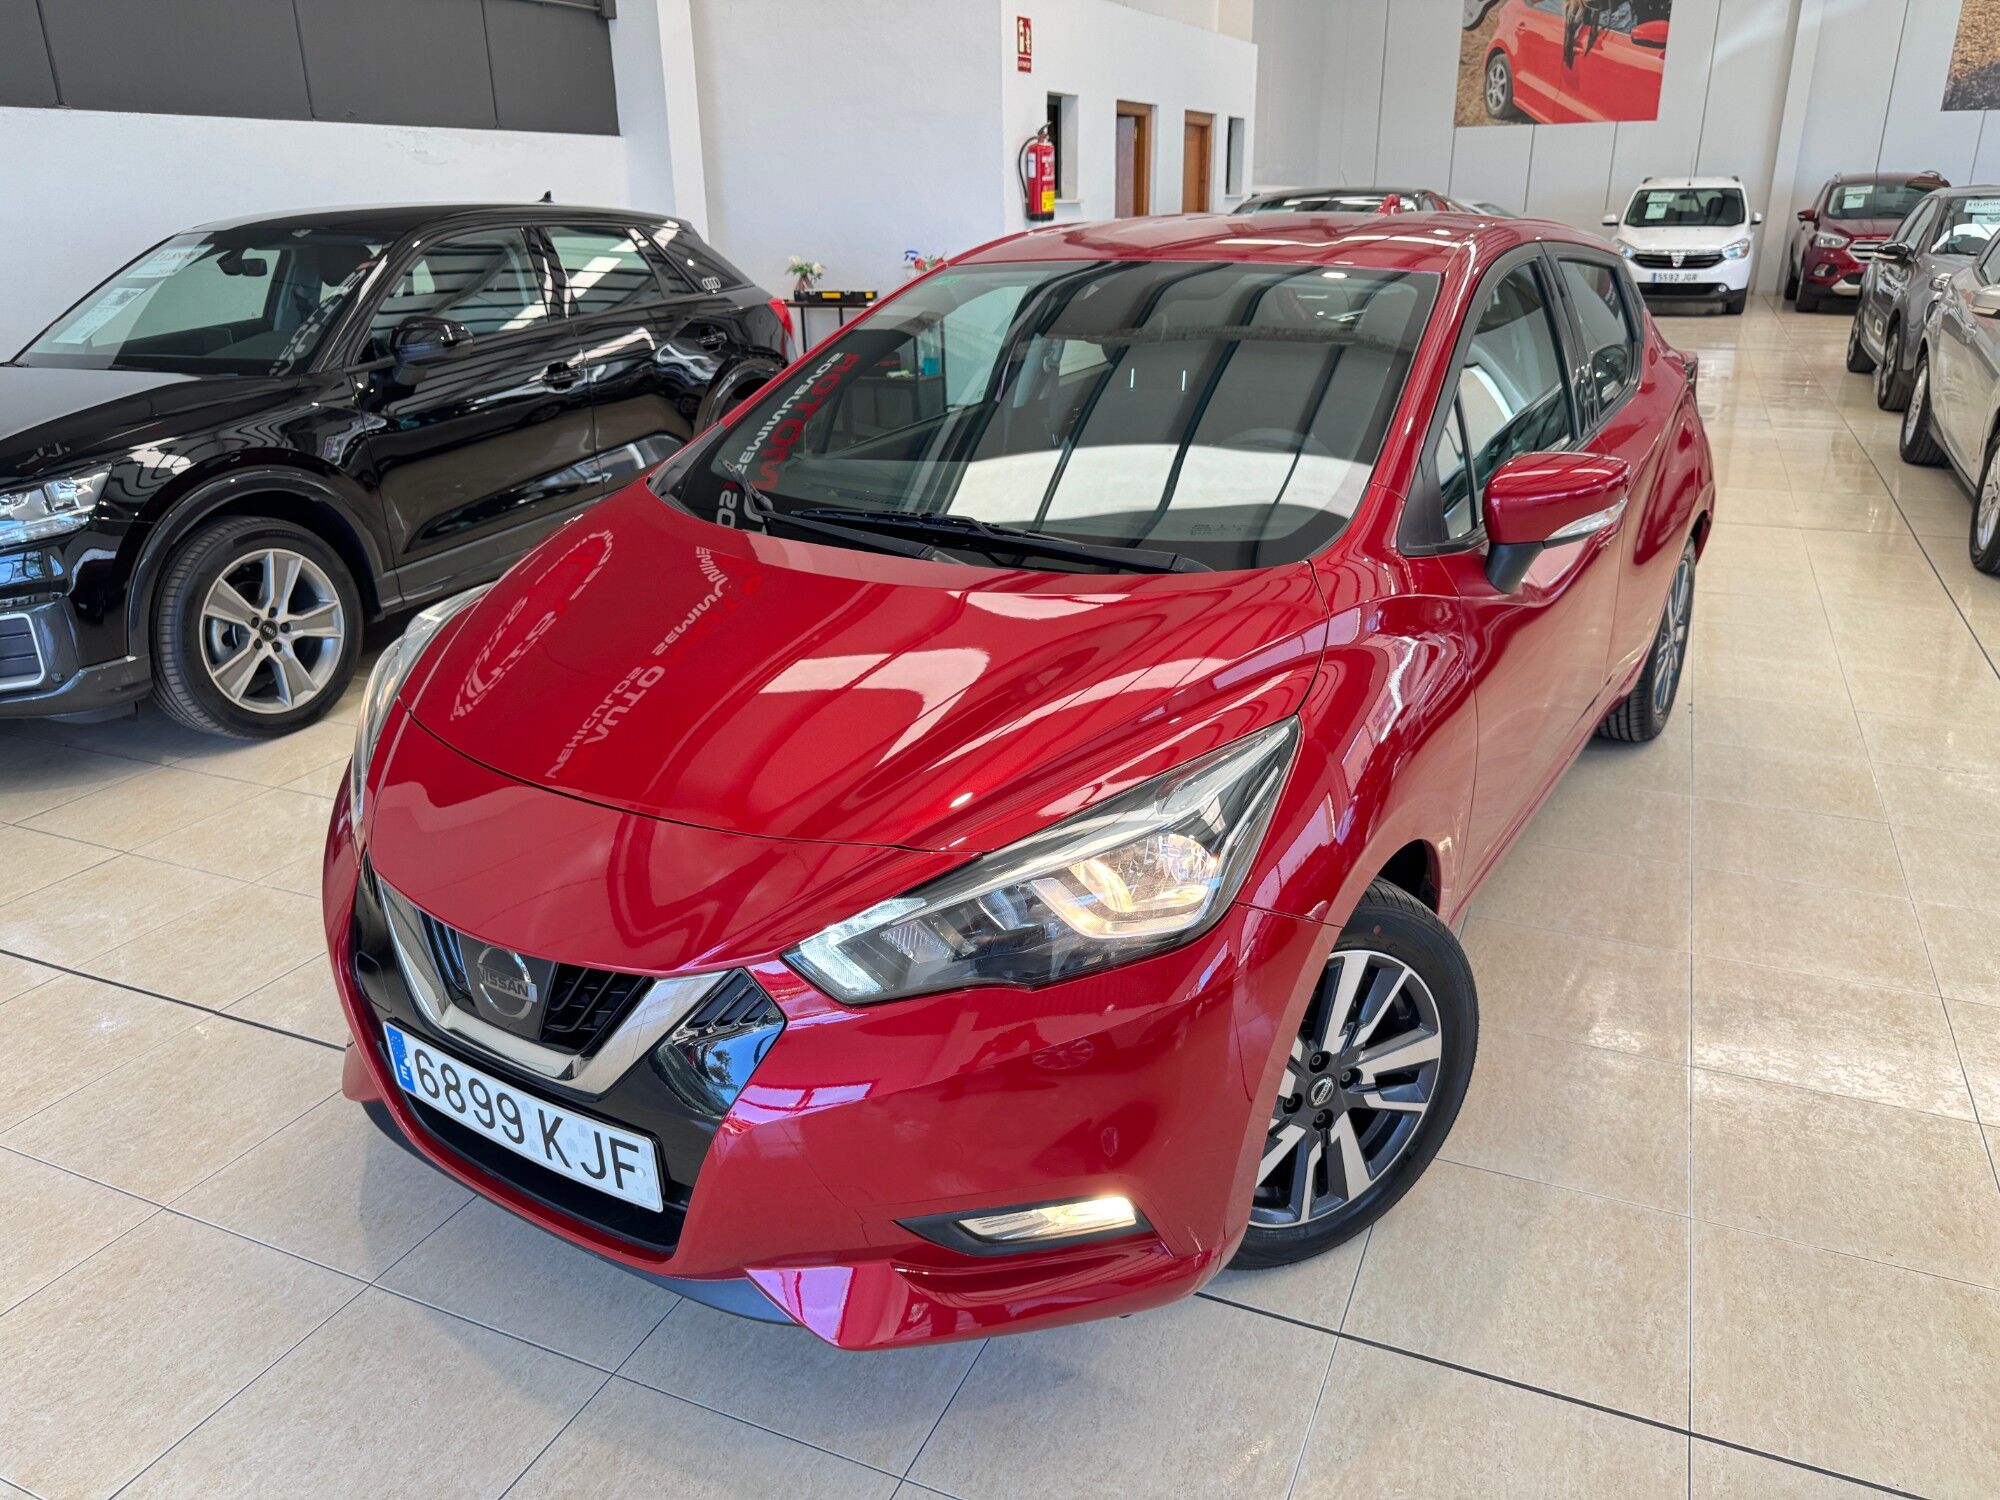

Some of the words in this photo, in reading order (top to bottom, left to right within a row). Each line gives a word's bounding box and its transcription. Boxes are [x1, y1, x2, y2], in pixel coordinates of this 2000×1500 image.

[479, 967, 529, 997] NISSAN
[414, 1048, 526, 1145] 6899
[537, 1107, 640, 1191] KJF
